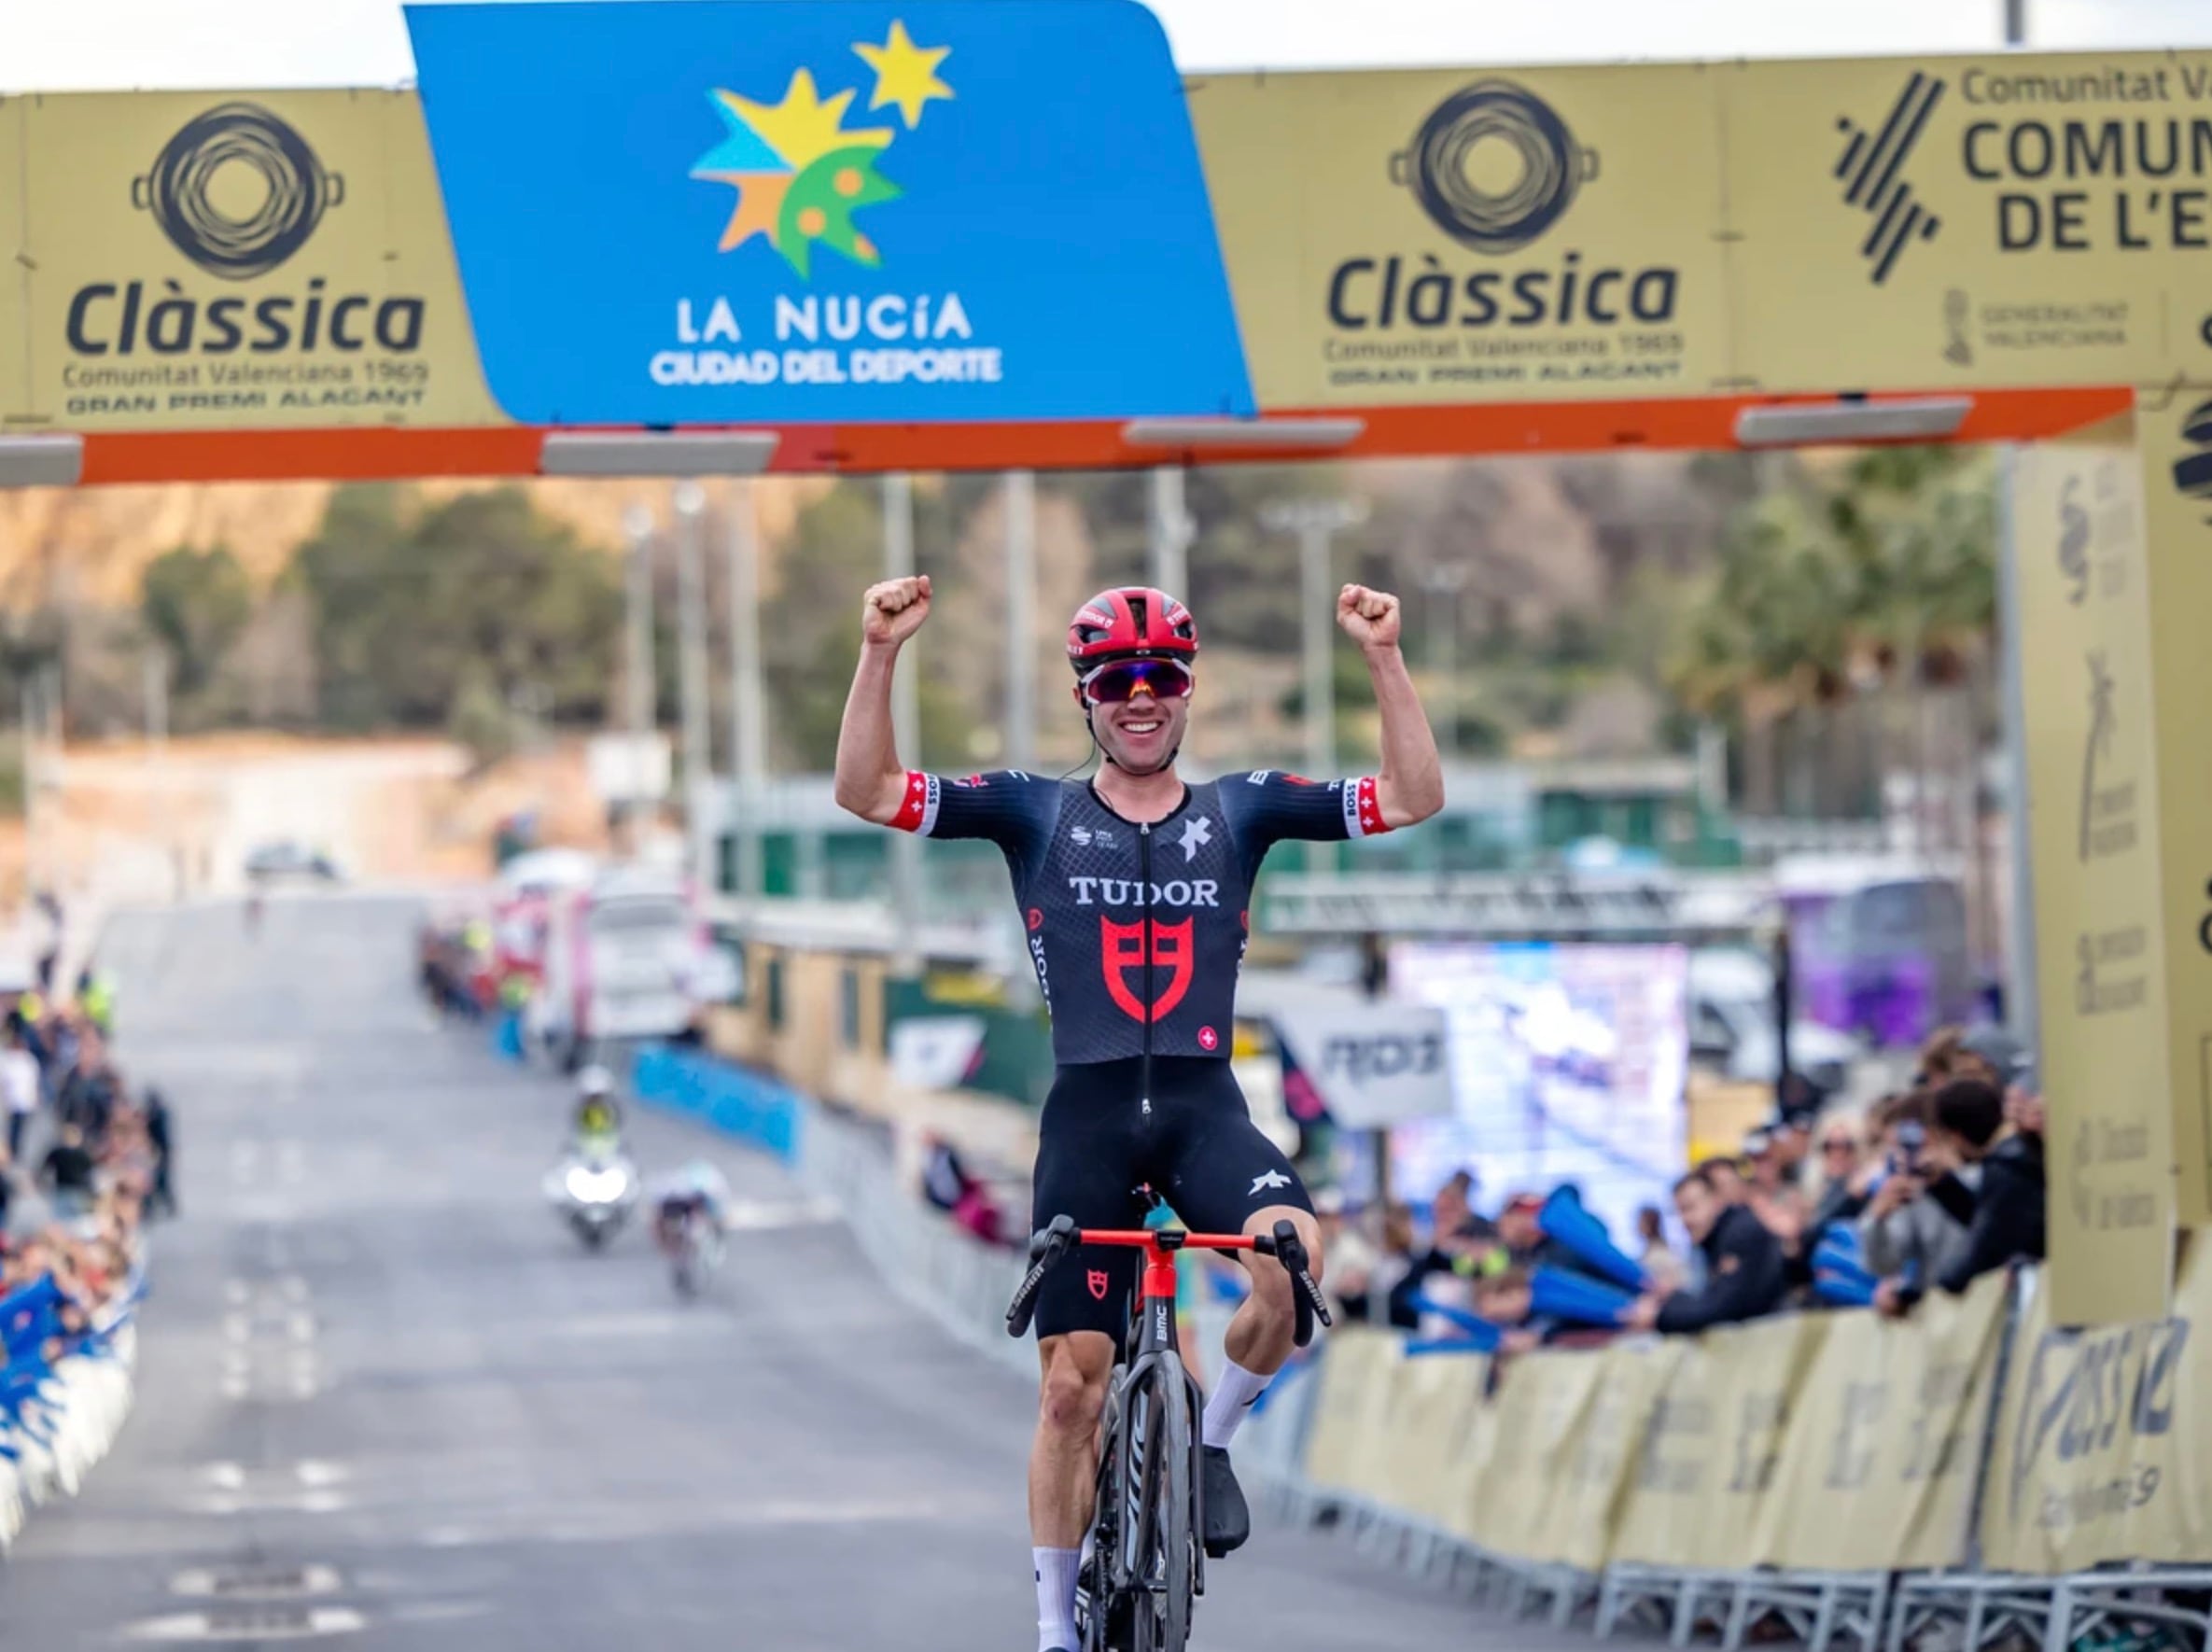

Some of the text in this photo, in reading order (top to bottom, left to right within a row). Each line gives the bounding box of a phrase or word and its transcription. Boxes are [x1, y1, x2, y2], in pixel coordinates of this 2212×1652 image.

[1962, 65, 2212, 105] Comunitat V
[1998, 189, 2209, 252] DE L'E
[1326, 250, 1680, 329] Clàssica
[65, 278, 427, 357] Clàssica
[677, 296, 741, 343] LA
[649, 347, 1003, 385] CIUDAD DEL DEPORTE
[1326, 336, 1459, 361] Comunitat
[1471, 335, 1610, 357] Valenciana
[63, 361, 429, 389] Comunitat Valenciana 1969
[66, 388, 427, 415] GRAN PREMI ALACANT
[1346, 783, 1357, 817] BOSS
[1069, 876, 1219, 907] TUDOR
